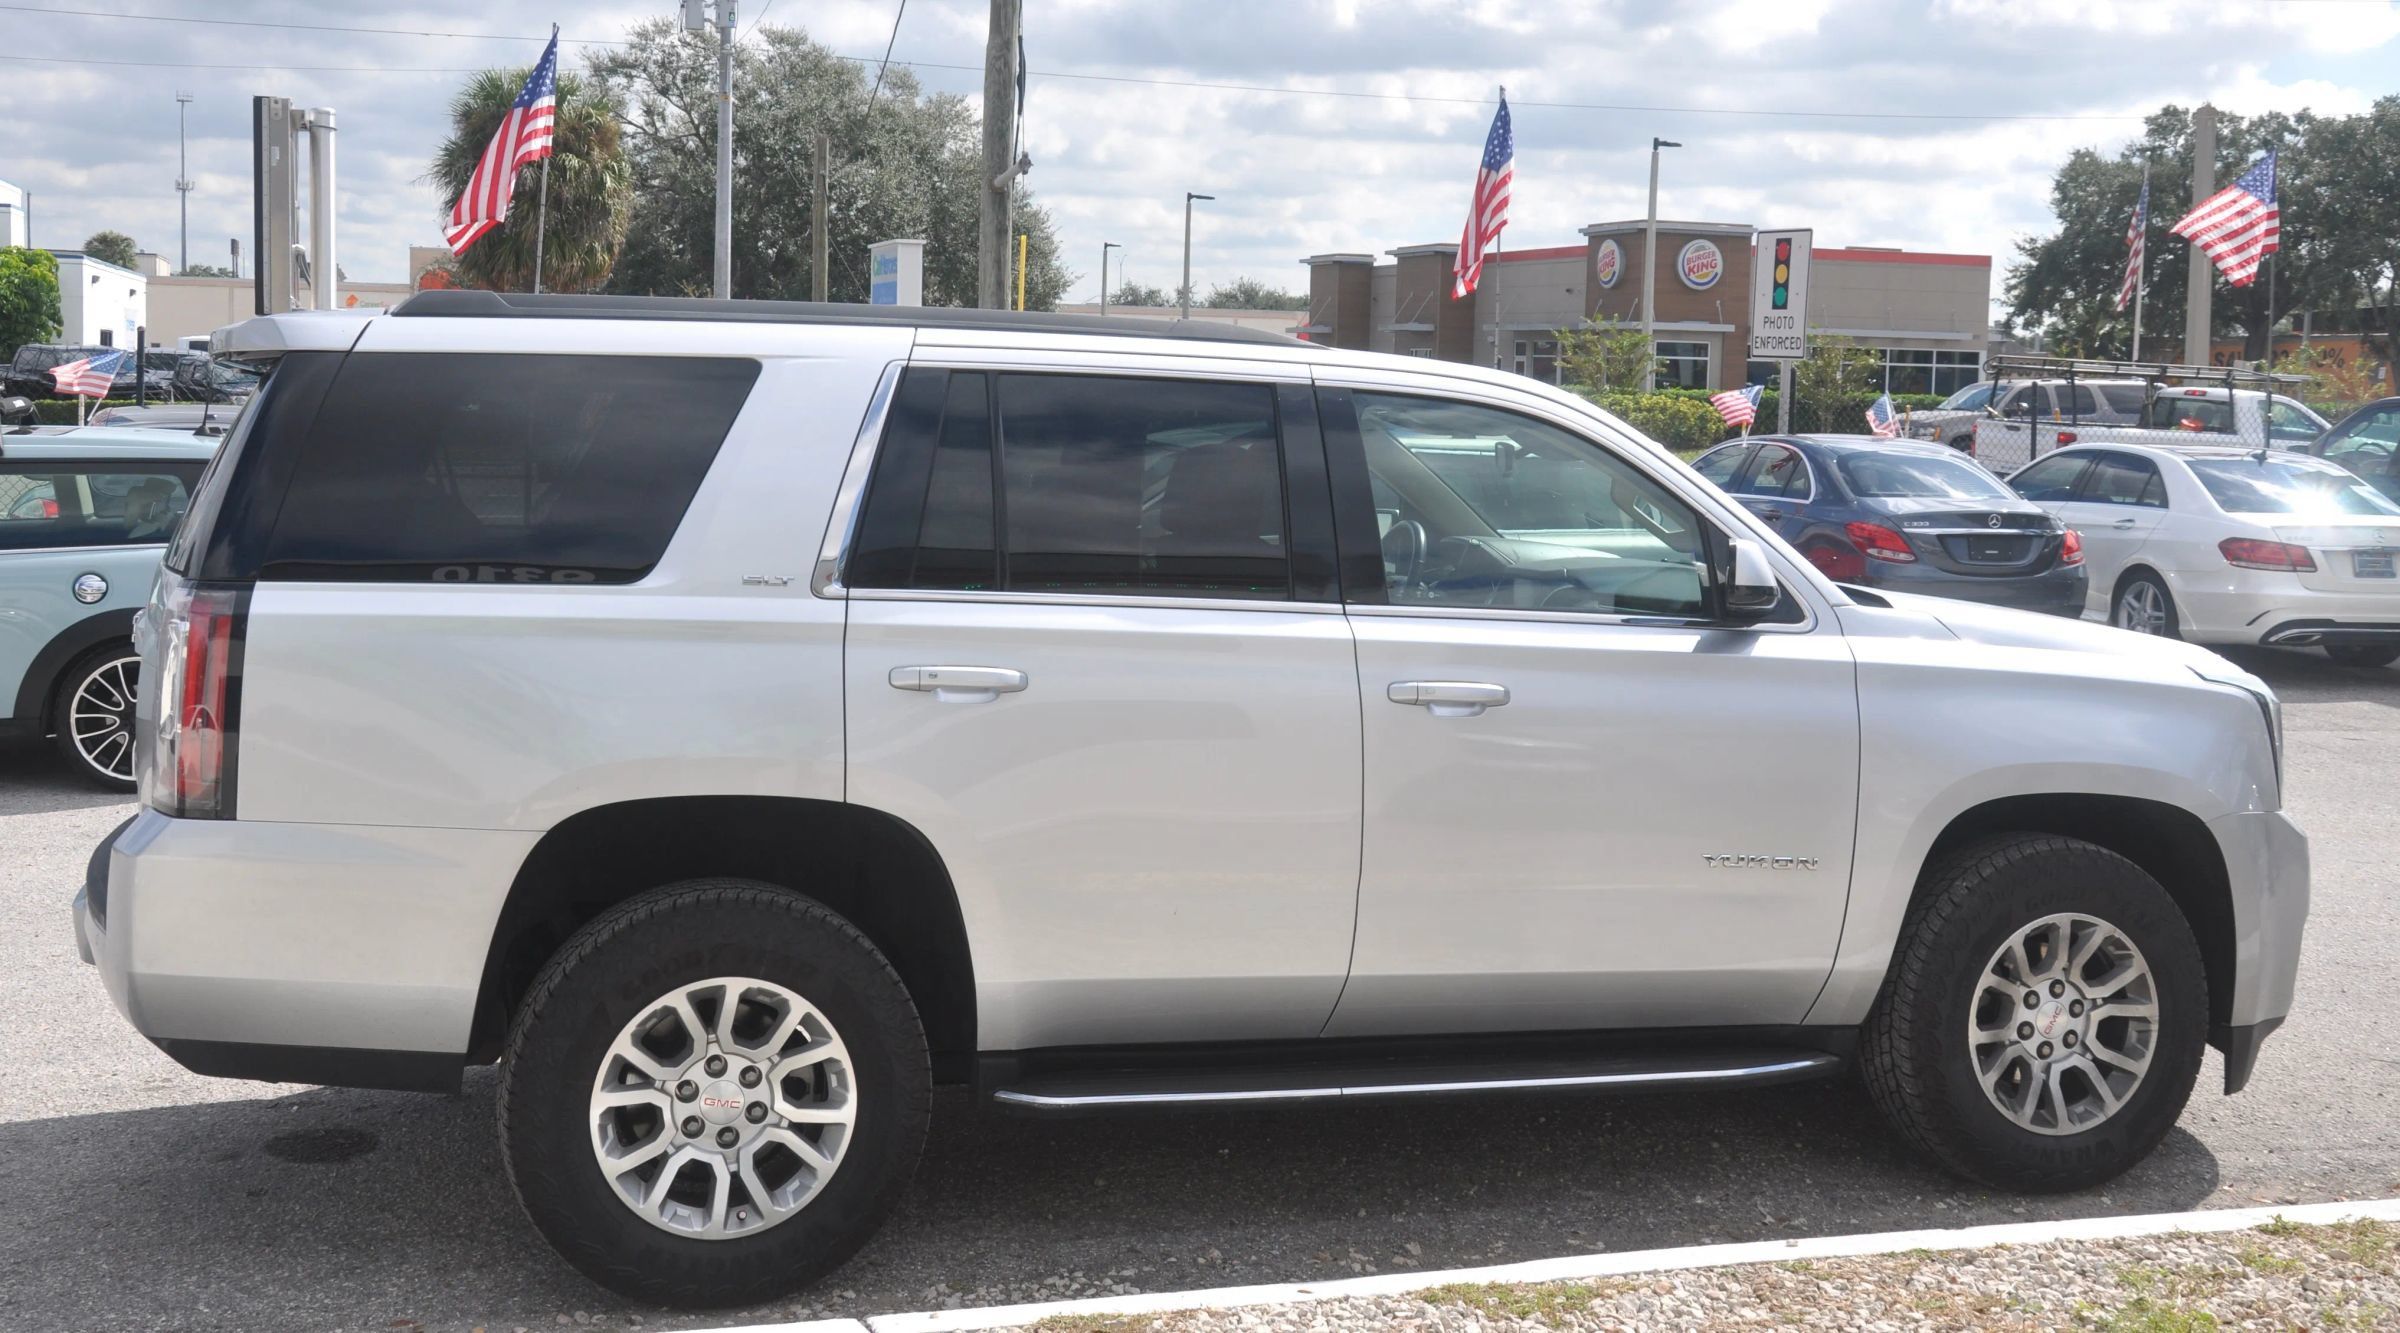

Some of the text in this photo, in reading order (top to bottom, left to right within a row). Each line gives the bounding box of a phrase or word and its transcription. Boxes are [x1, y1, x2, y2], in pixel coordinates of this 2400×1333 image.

[1687, 250, 1717, 266] BURGER
[1687, 259, 1718, 277] KING
[1763, 315, 1795, 330] PHOTO
[1754, 335, 1802, 350] ENFORCED
[742, 575, 795, 587] SLT
[1702, 854, 1819, 871] YUKON
[2043, 1005, 2063, 1036] GMC
[704, 1097, 740, 1109] GMC
